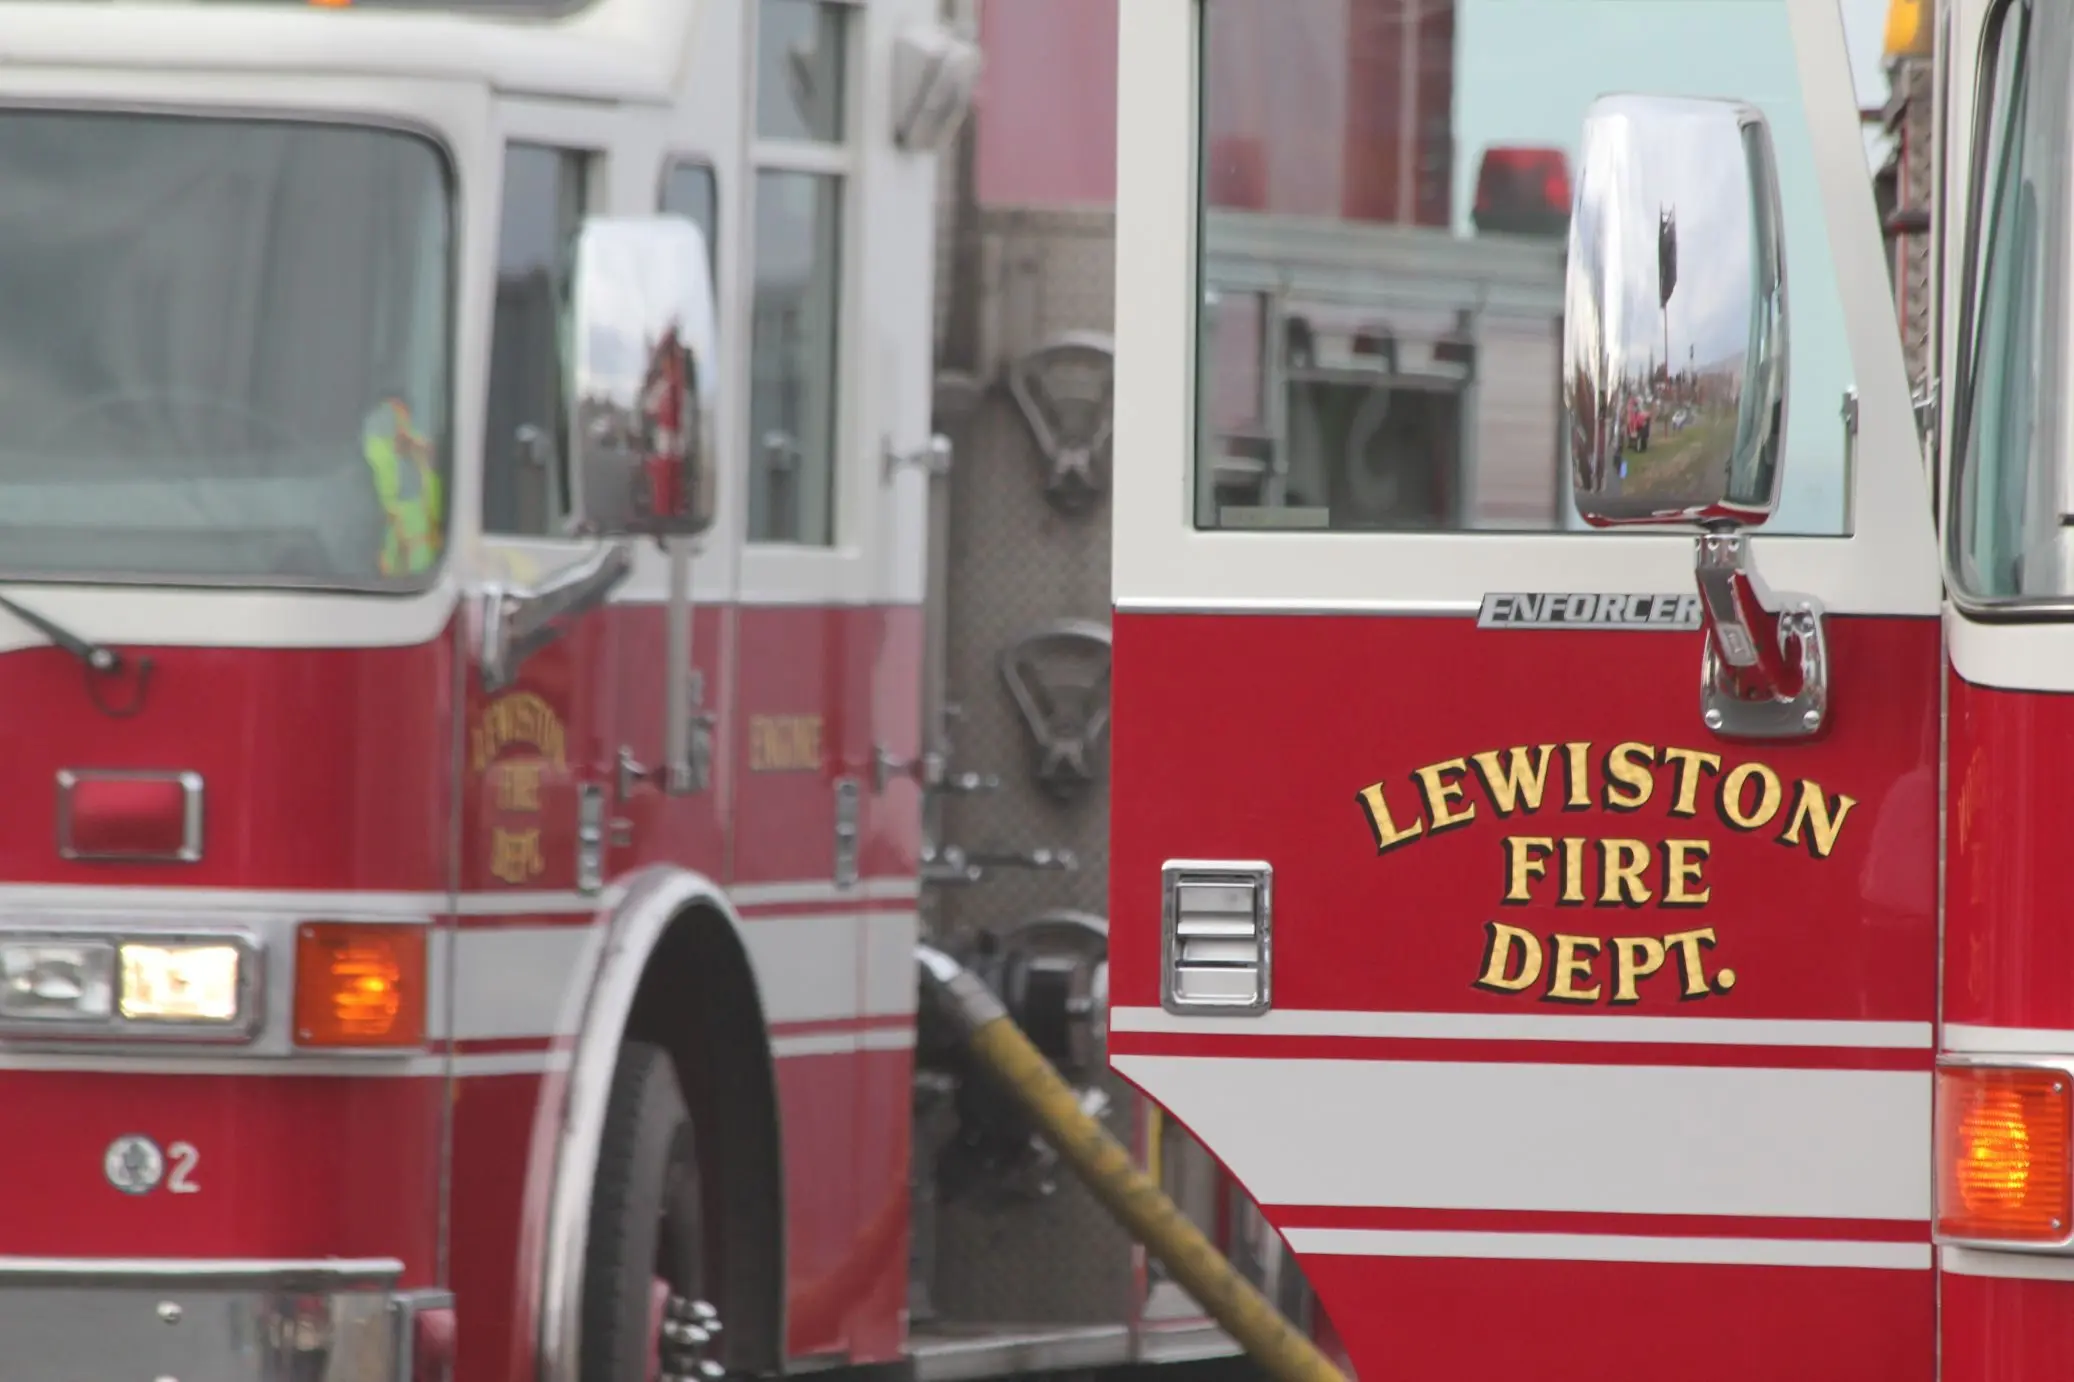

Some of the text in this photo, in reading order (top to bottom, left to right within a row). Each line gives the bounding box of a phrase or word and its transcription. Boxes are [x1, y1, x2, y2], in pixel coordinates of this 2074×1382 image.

[1489, 593, 1701, 623] ENFORCER
[1356, 741, 1857, 858] LEWISTON
[1501, 836, 1711, 906] FIRE
[1472, 920, 1737, 1006] DEPT.
[167, 1141, 201, 1193] 2
